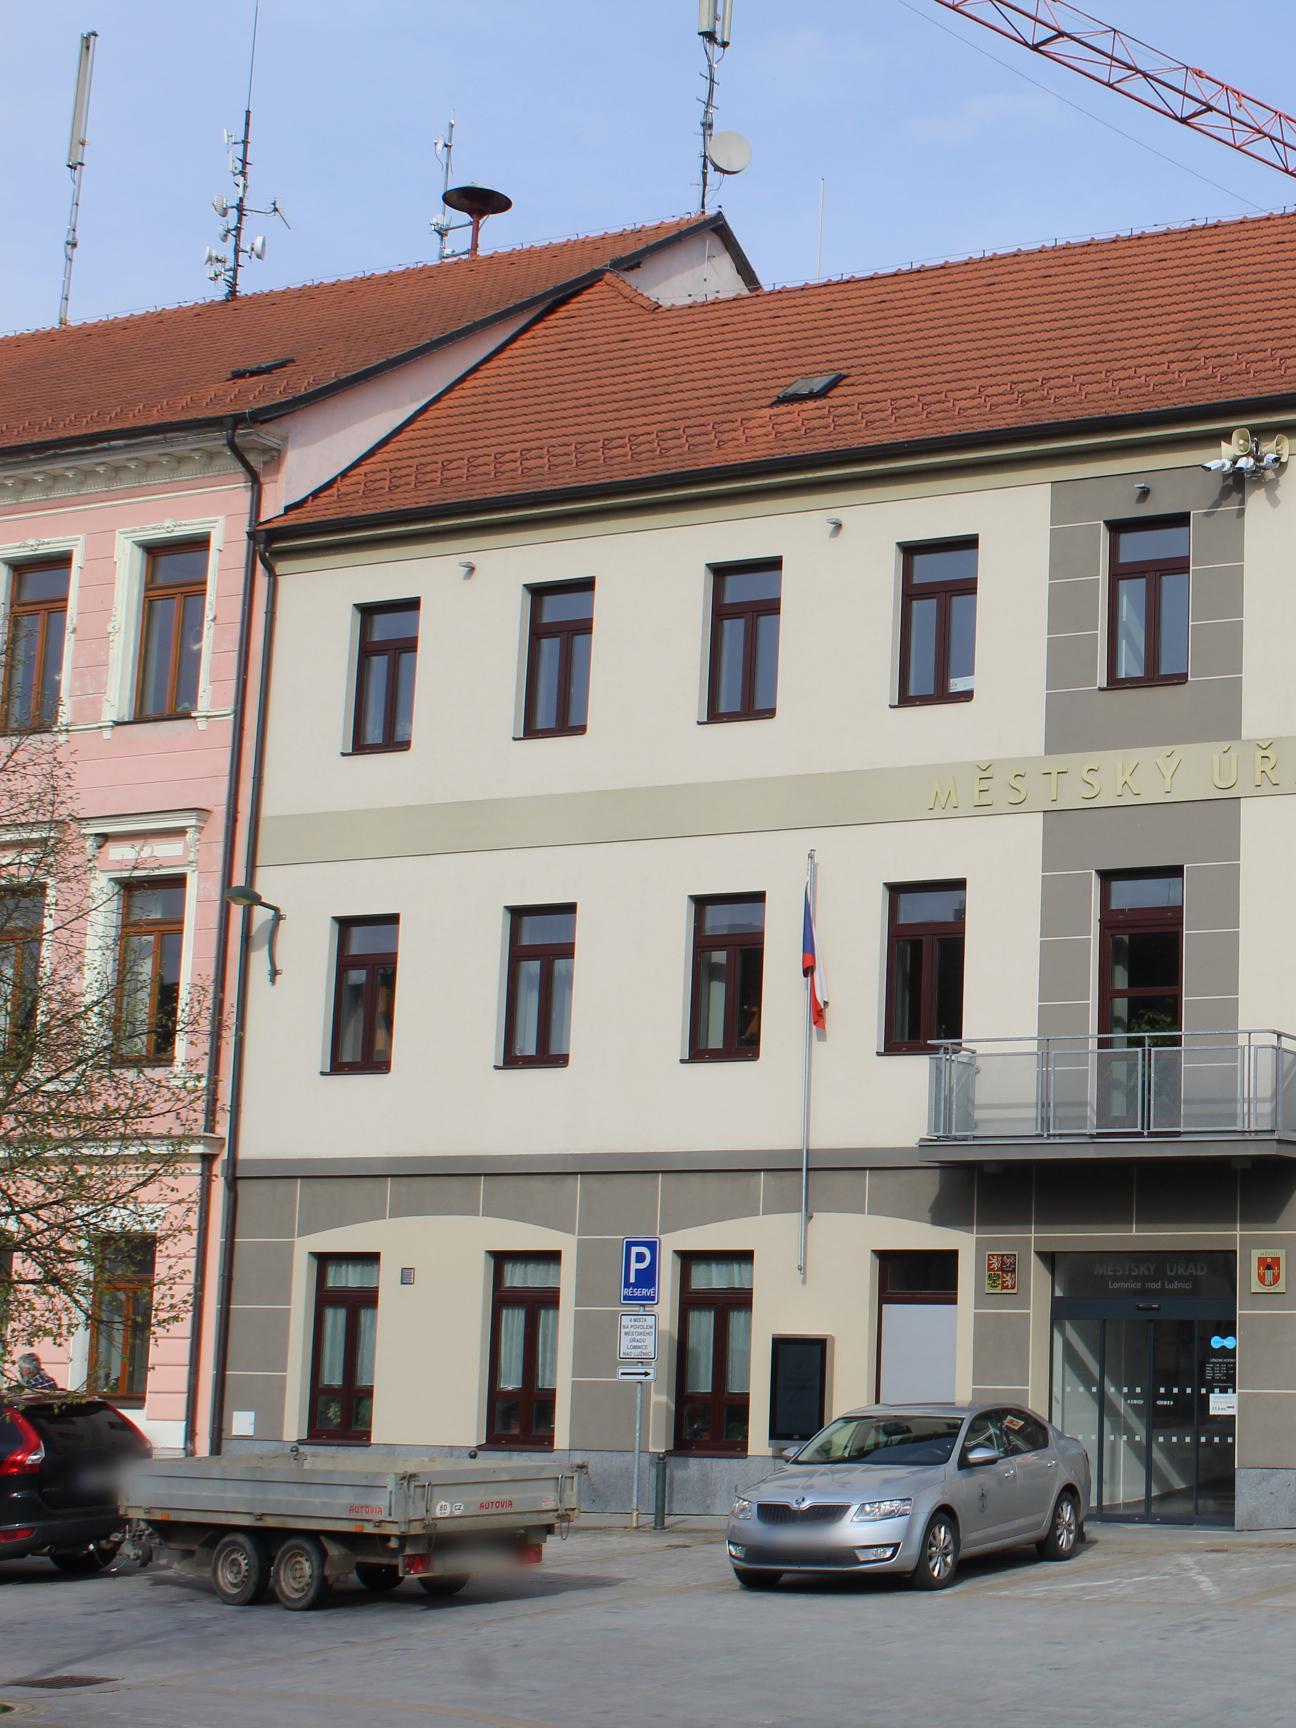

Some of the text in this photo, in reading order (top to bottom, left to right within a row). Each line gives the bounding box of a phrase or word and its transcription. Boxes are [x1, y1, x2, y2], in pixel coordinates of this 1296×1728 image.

[928, 750, 1183, 810] MĚSTSKÝ
[629, 1246, 651, 1283] P
[1108, 1280, 1142, 1289] Lomnice
[1145, 1280, 1162, 1289] nad
[623, 1286, 656, 1296] RÉSERVÉ
[348, 1504, 383, 1515] AUTOVIA
[480, 1500, 513, 1510] AUTOVIA
